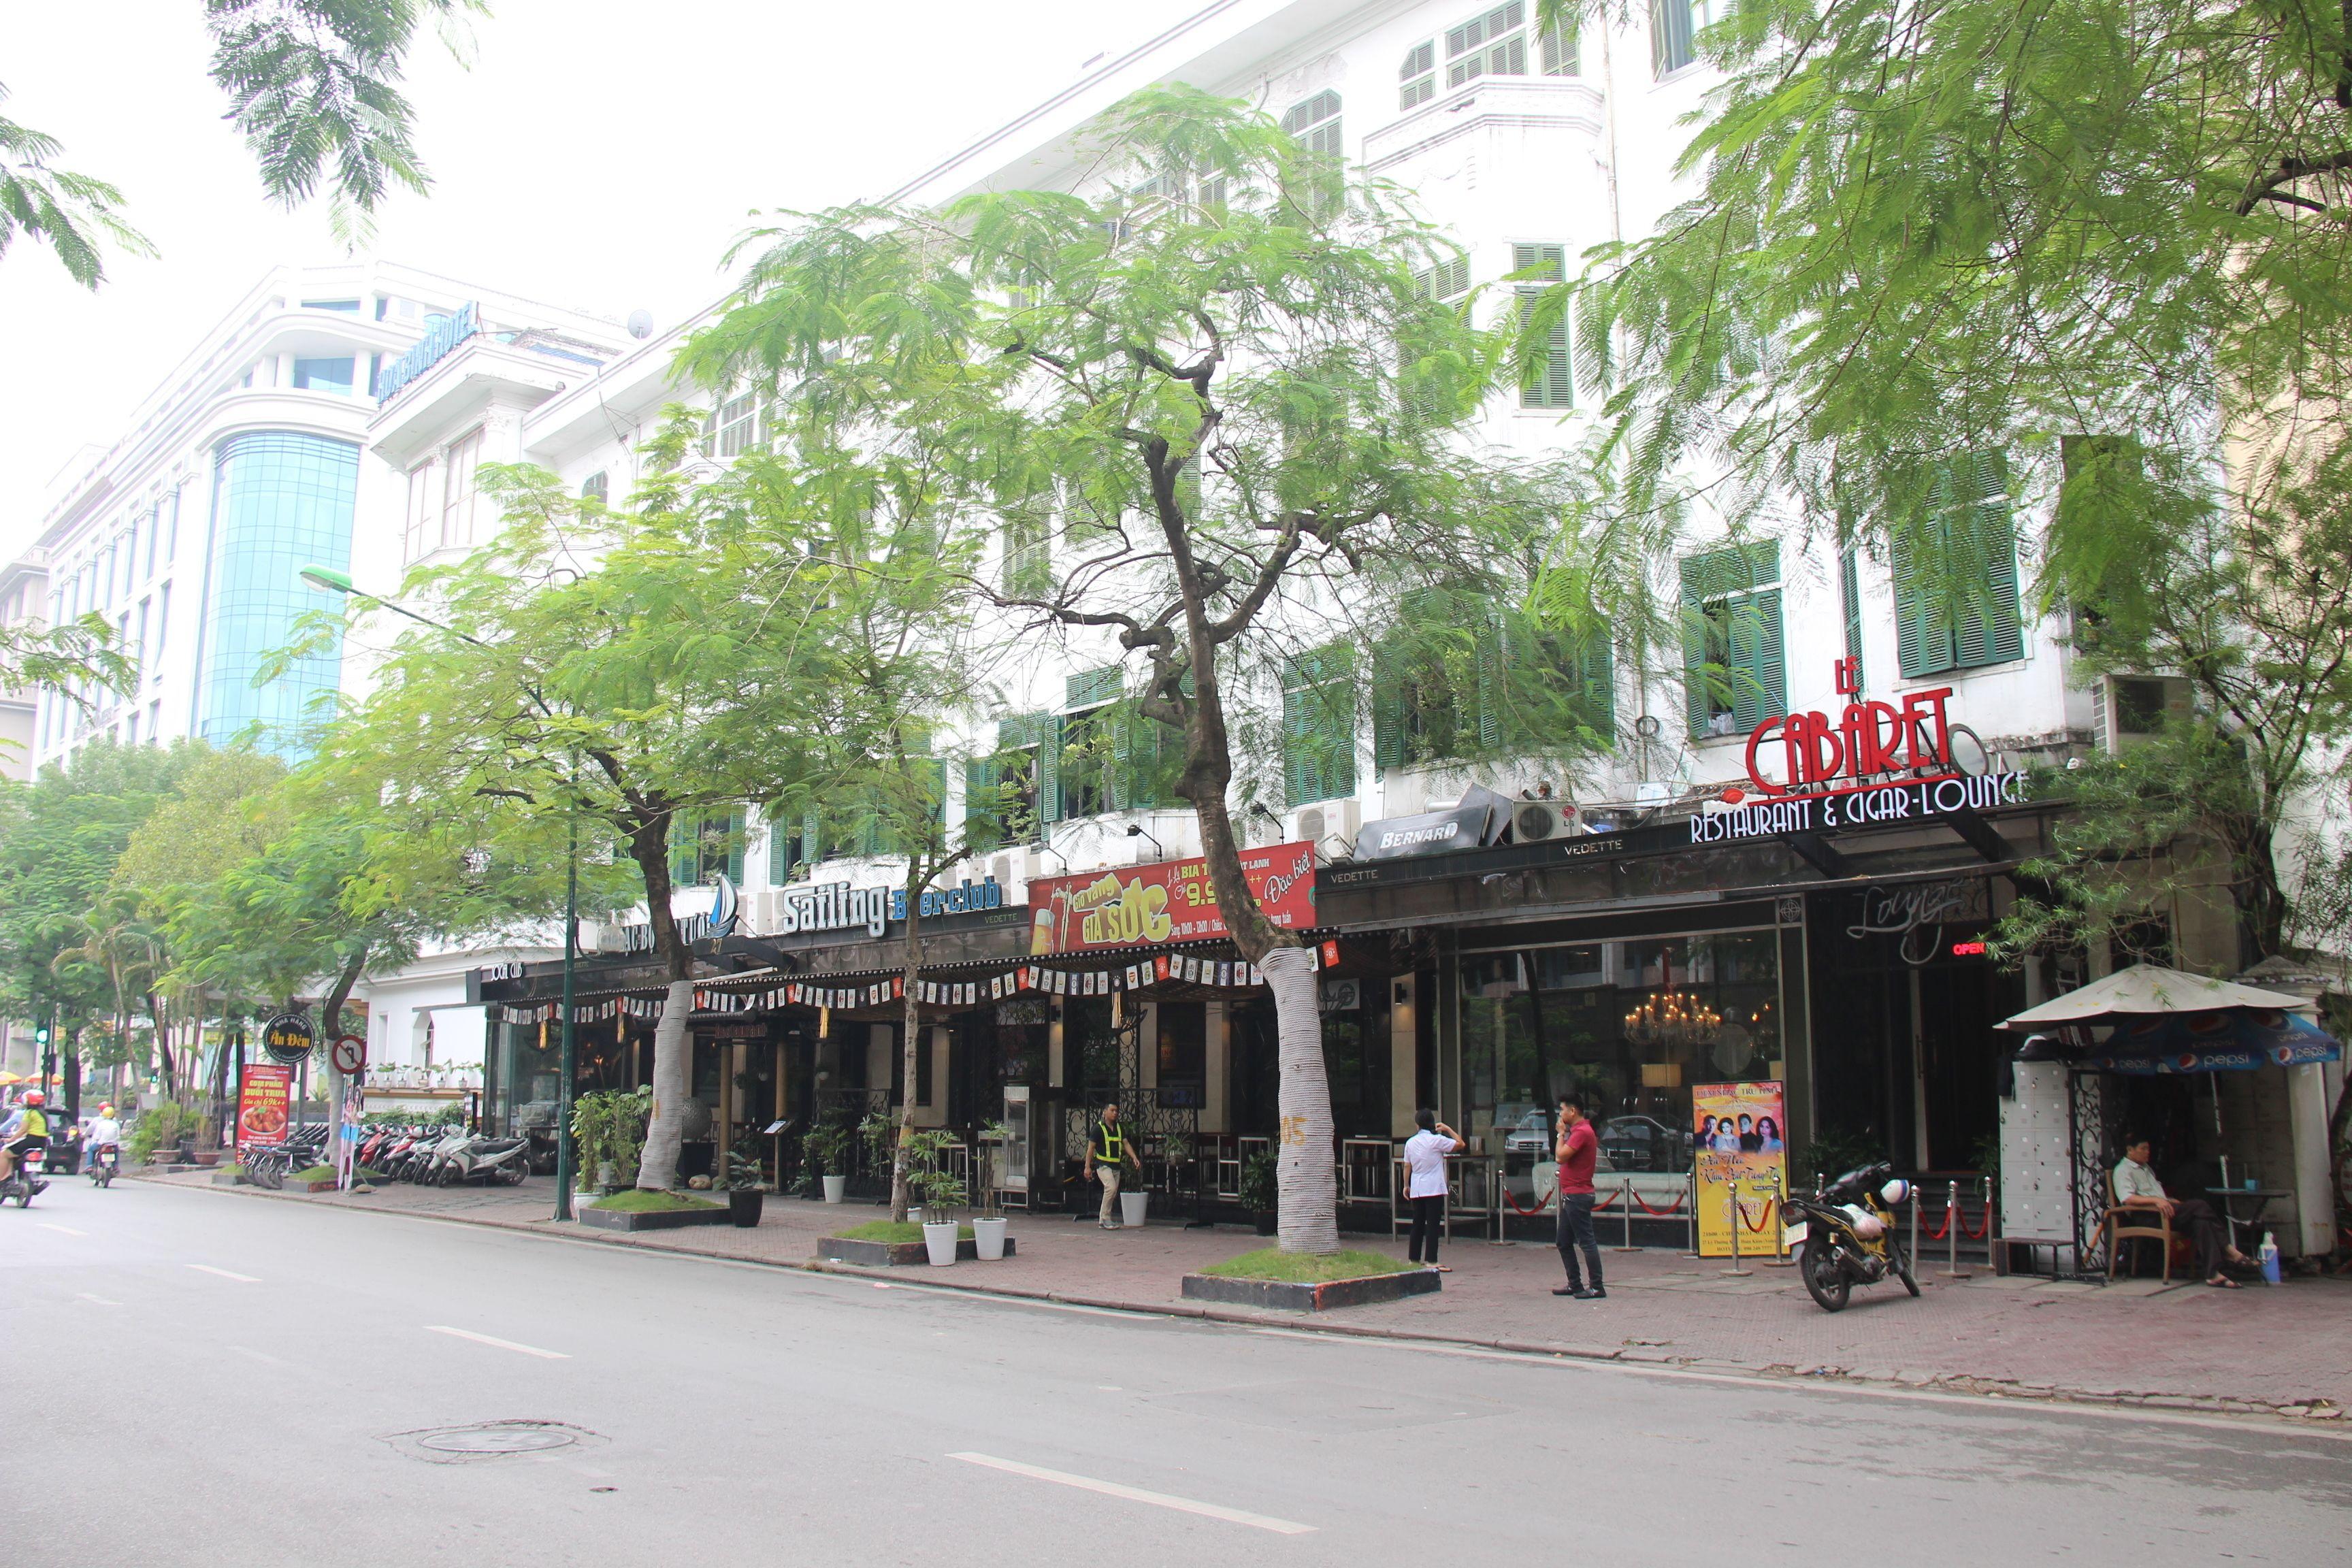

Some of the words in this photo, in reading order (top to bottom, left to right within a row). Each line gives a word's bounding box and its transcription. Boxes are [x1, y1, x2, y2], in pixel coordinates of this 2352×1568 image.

[1835, 655, 1860, 695] LE
[1746, 687, 1953, 795] CABARET
[1690, 798, 1813, 843] RESTAURANT
[1379, 822, 1458, 849] BERNARD
[1565, 839, 1623, 855] VEDETTE
[1181, 864, 1200, 879] BIA
[1250, 858, 1270, 870] LẠNH
[1264, 875, 1293, 903] Đặc
[1292, 849, 1311, 880] biệt
[1330, 869, 1378, 883] VEDETTE
[783, 881, 888, 938] Sailing
[985, 913, 1017, 924] VEDETTE
[710, 938, 723, 954] 27
[1953, 942, 1986, 956] OPEN
[510, 962, 523, 979] CLUB
[2295, 1044, 2328, 1058] pepsi
[2119, 1058, 2151, 1070] pepsi
[2204, 1053, 2250, 1068] pepsi
